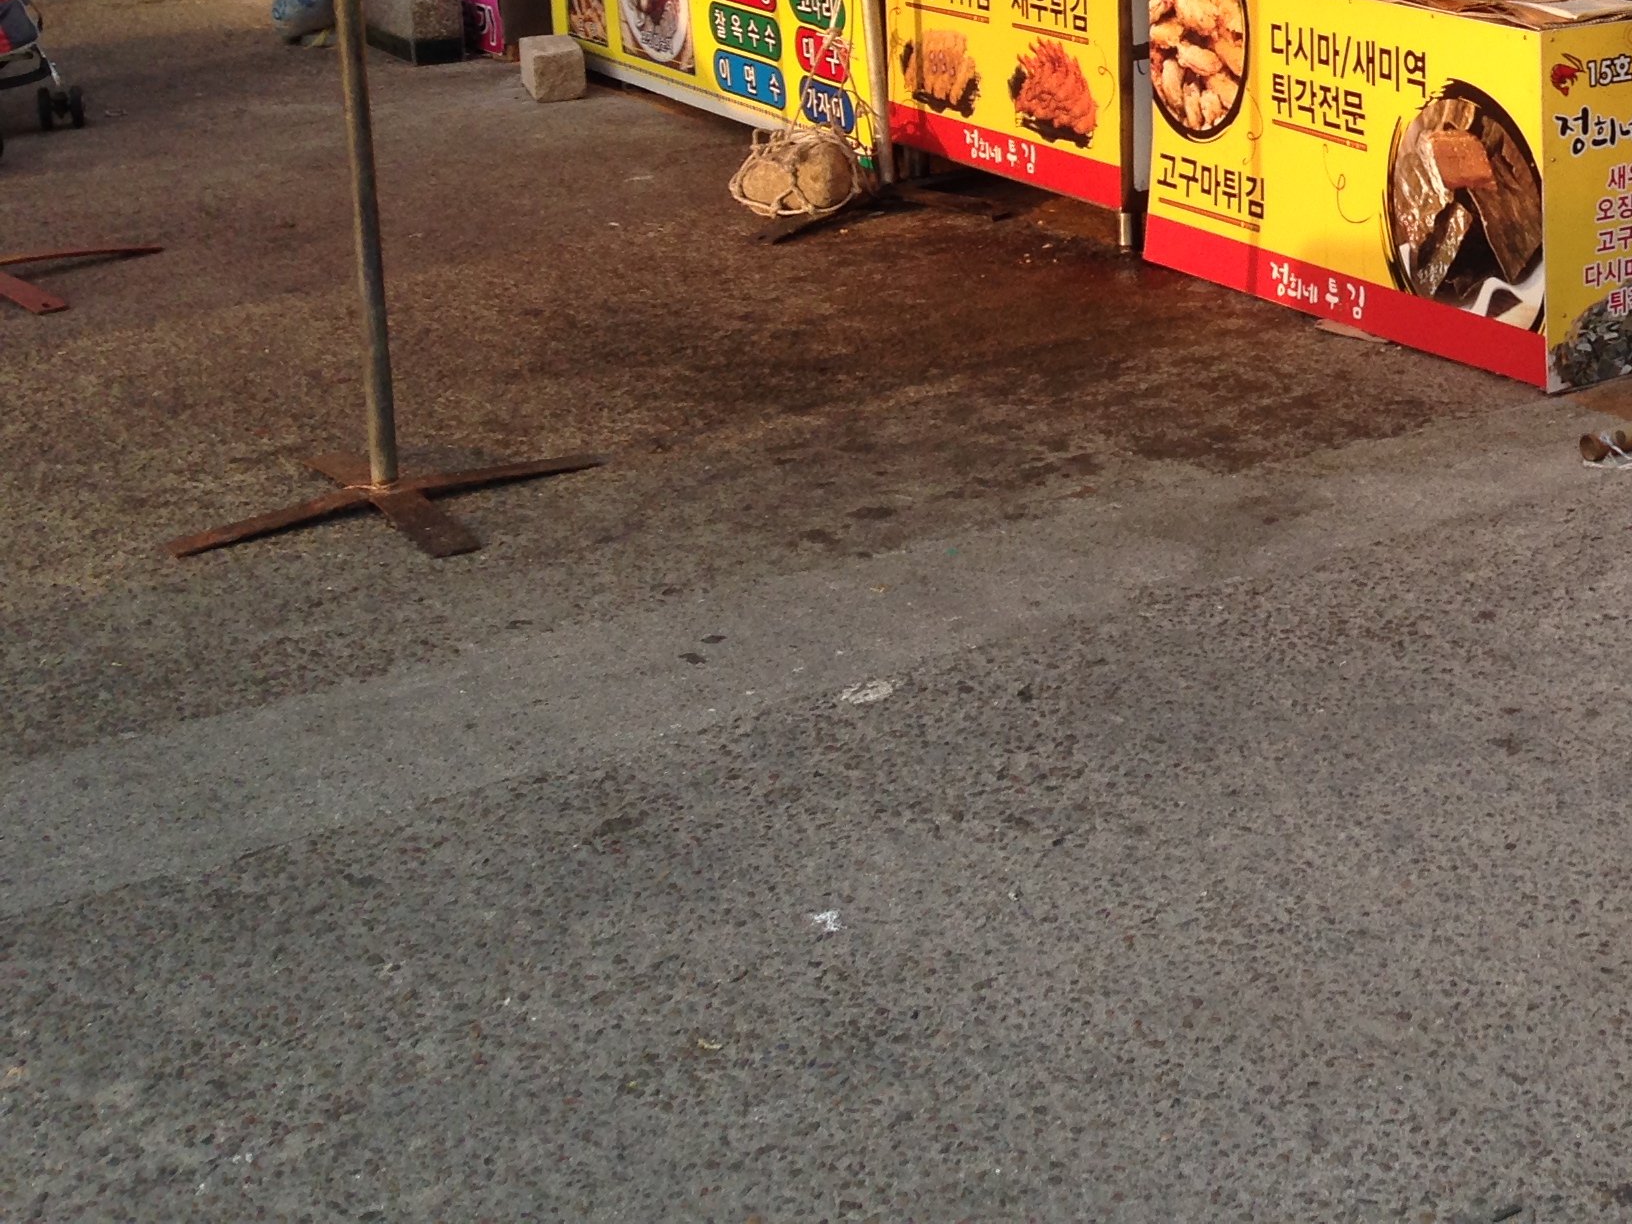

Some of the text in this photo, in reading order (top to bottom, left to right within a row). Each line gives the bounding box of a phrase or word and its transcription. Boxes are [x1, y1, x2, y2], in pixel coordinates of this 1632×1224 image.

[713, 8, 777, 53] 찰옥수수
[718, 57, 781, 103] 이면수
[1270, 22, 1427, 98] 다시마/새미역
[806, 87, 845, 127] 가자미
[1271, 72, 1366, 136] 튀각전문
[963, 128, 1002, 163] 정희네
[1156, 152, 1265, 220] 고구마튀김
[1269, 261, 1319, 304] 정희네
